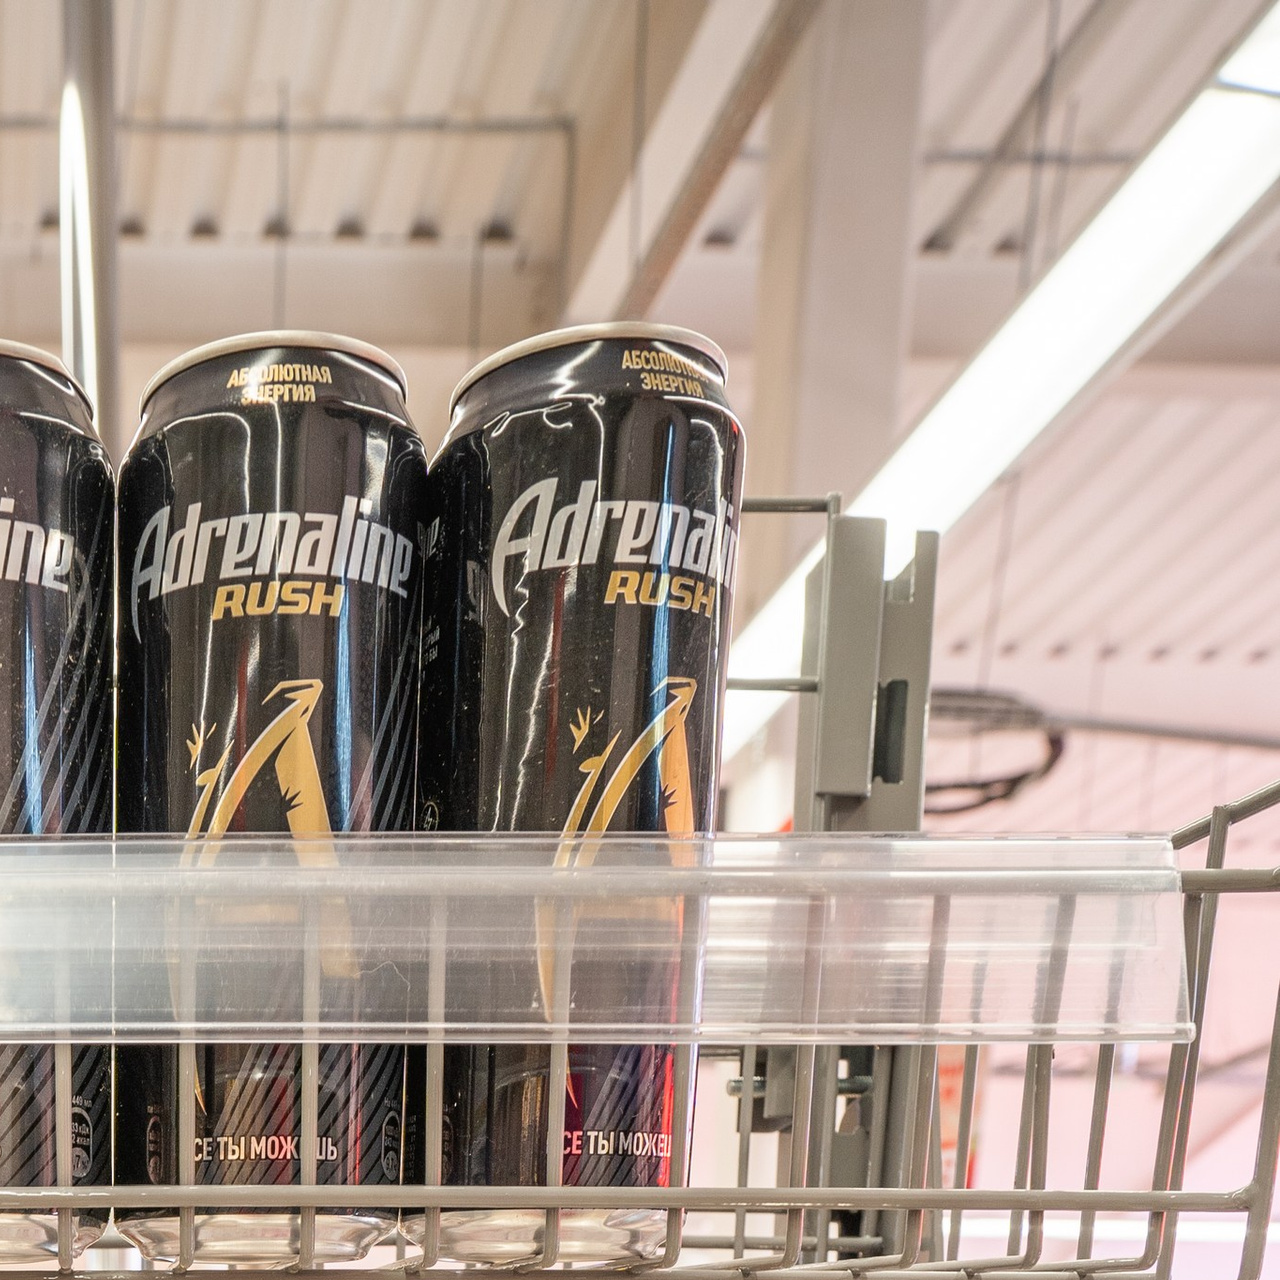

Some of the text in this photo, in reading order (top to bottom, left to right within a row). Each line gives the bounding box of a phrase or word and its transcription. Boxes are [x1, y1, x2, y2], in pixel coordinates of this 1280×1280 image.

[226, 364, 333, 389] АБСОЛЮТНАЯ
[621, 349, 709, 383] АБСОЛЮТНАЯ
[241, 384, 316, 406] ЭНЕРГИЯ
[640, 371, 704, 399] ЭНЕРГИЯ
[131, 494, 414, 644] Adrenaline
[211, 580, 346, 621] RUSH
[604, 570, 717, 618] RUSH
[194, 1136, 338, 1162] СЕ ТЫ МОЖШЬ
[563, 1130, 583, 1155] СЕ
[587, 1131, 614, 1155] ТЫ
